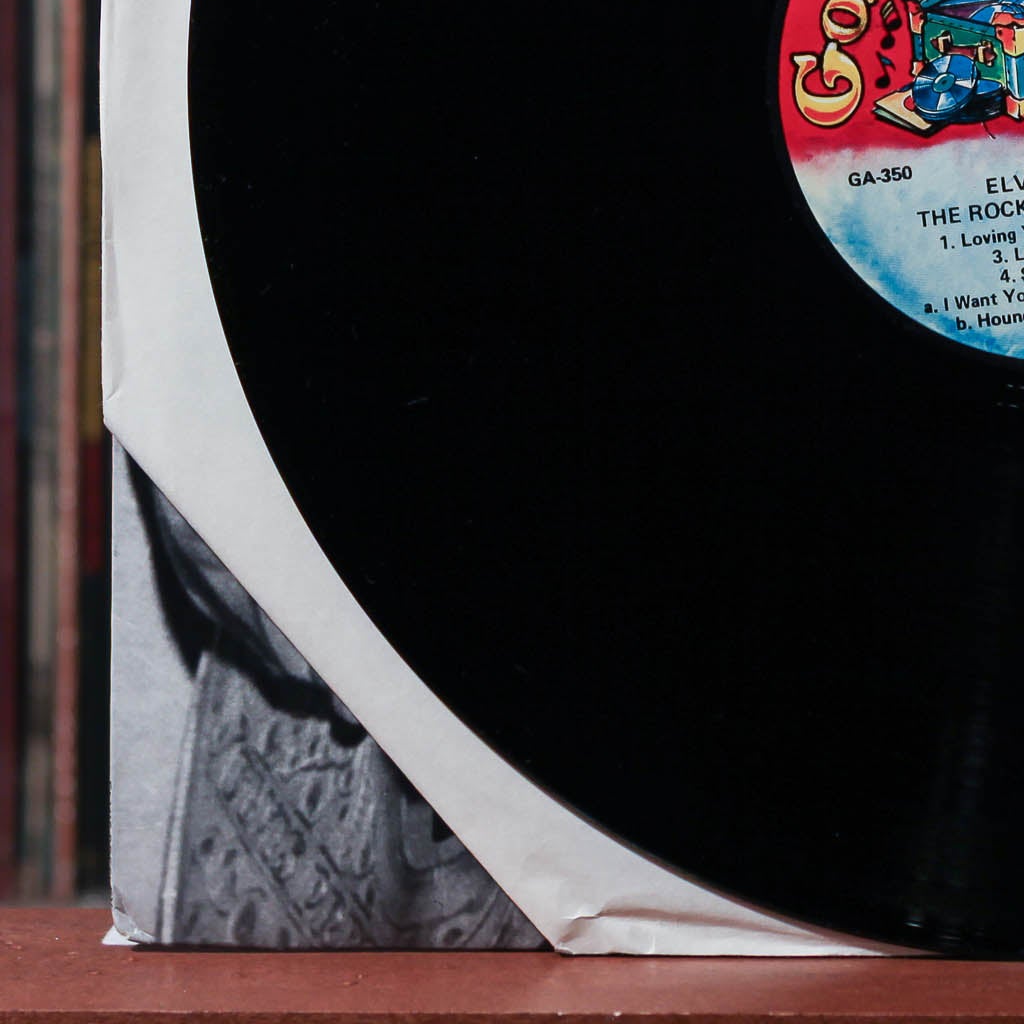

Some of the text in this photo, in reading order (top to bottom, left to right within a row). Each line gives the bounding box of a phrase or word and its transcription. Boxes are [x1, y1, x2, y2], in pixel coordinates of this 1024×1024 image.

[848, 166, 912, 186] GA-350
[917, 207, 961, 227] THE
[940, 236, 955, 249] 1.
[961, 229, 1017, 247] Loving
[993, 250, 1008, 263] 3.
[1000, 269, 1016, 283] 4.
[924, 303, 938, 313] a.
[944, 297, 949, 311] I
[955, 293, 998, 310] Want
[956, 316, 972, 331] b.
